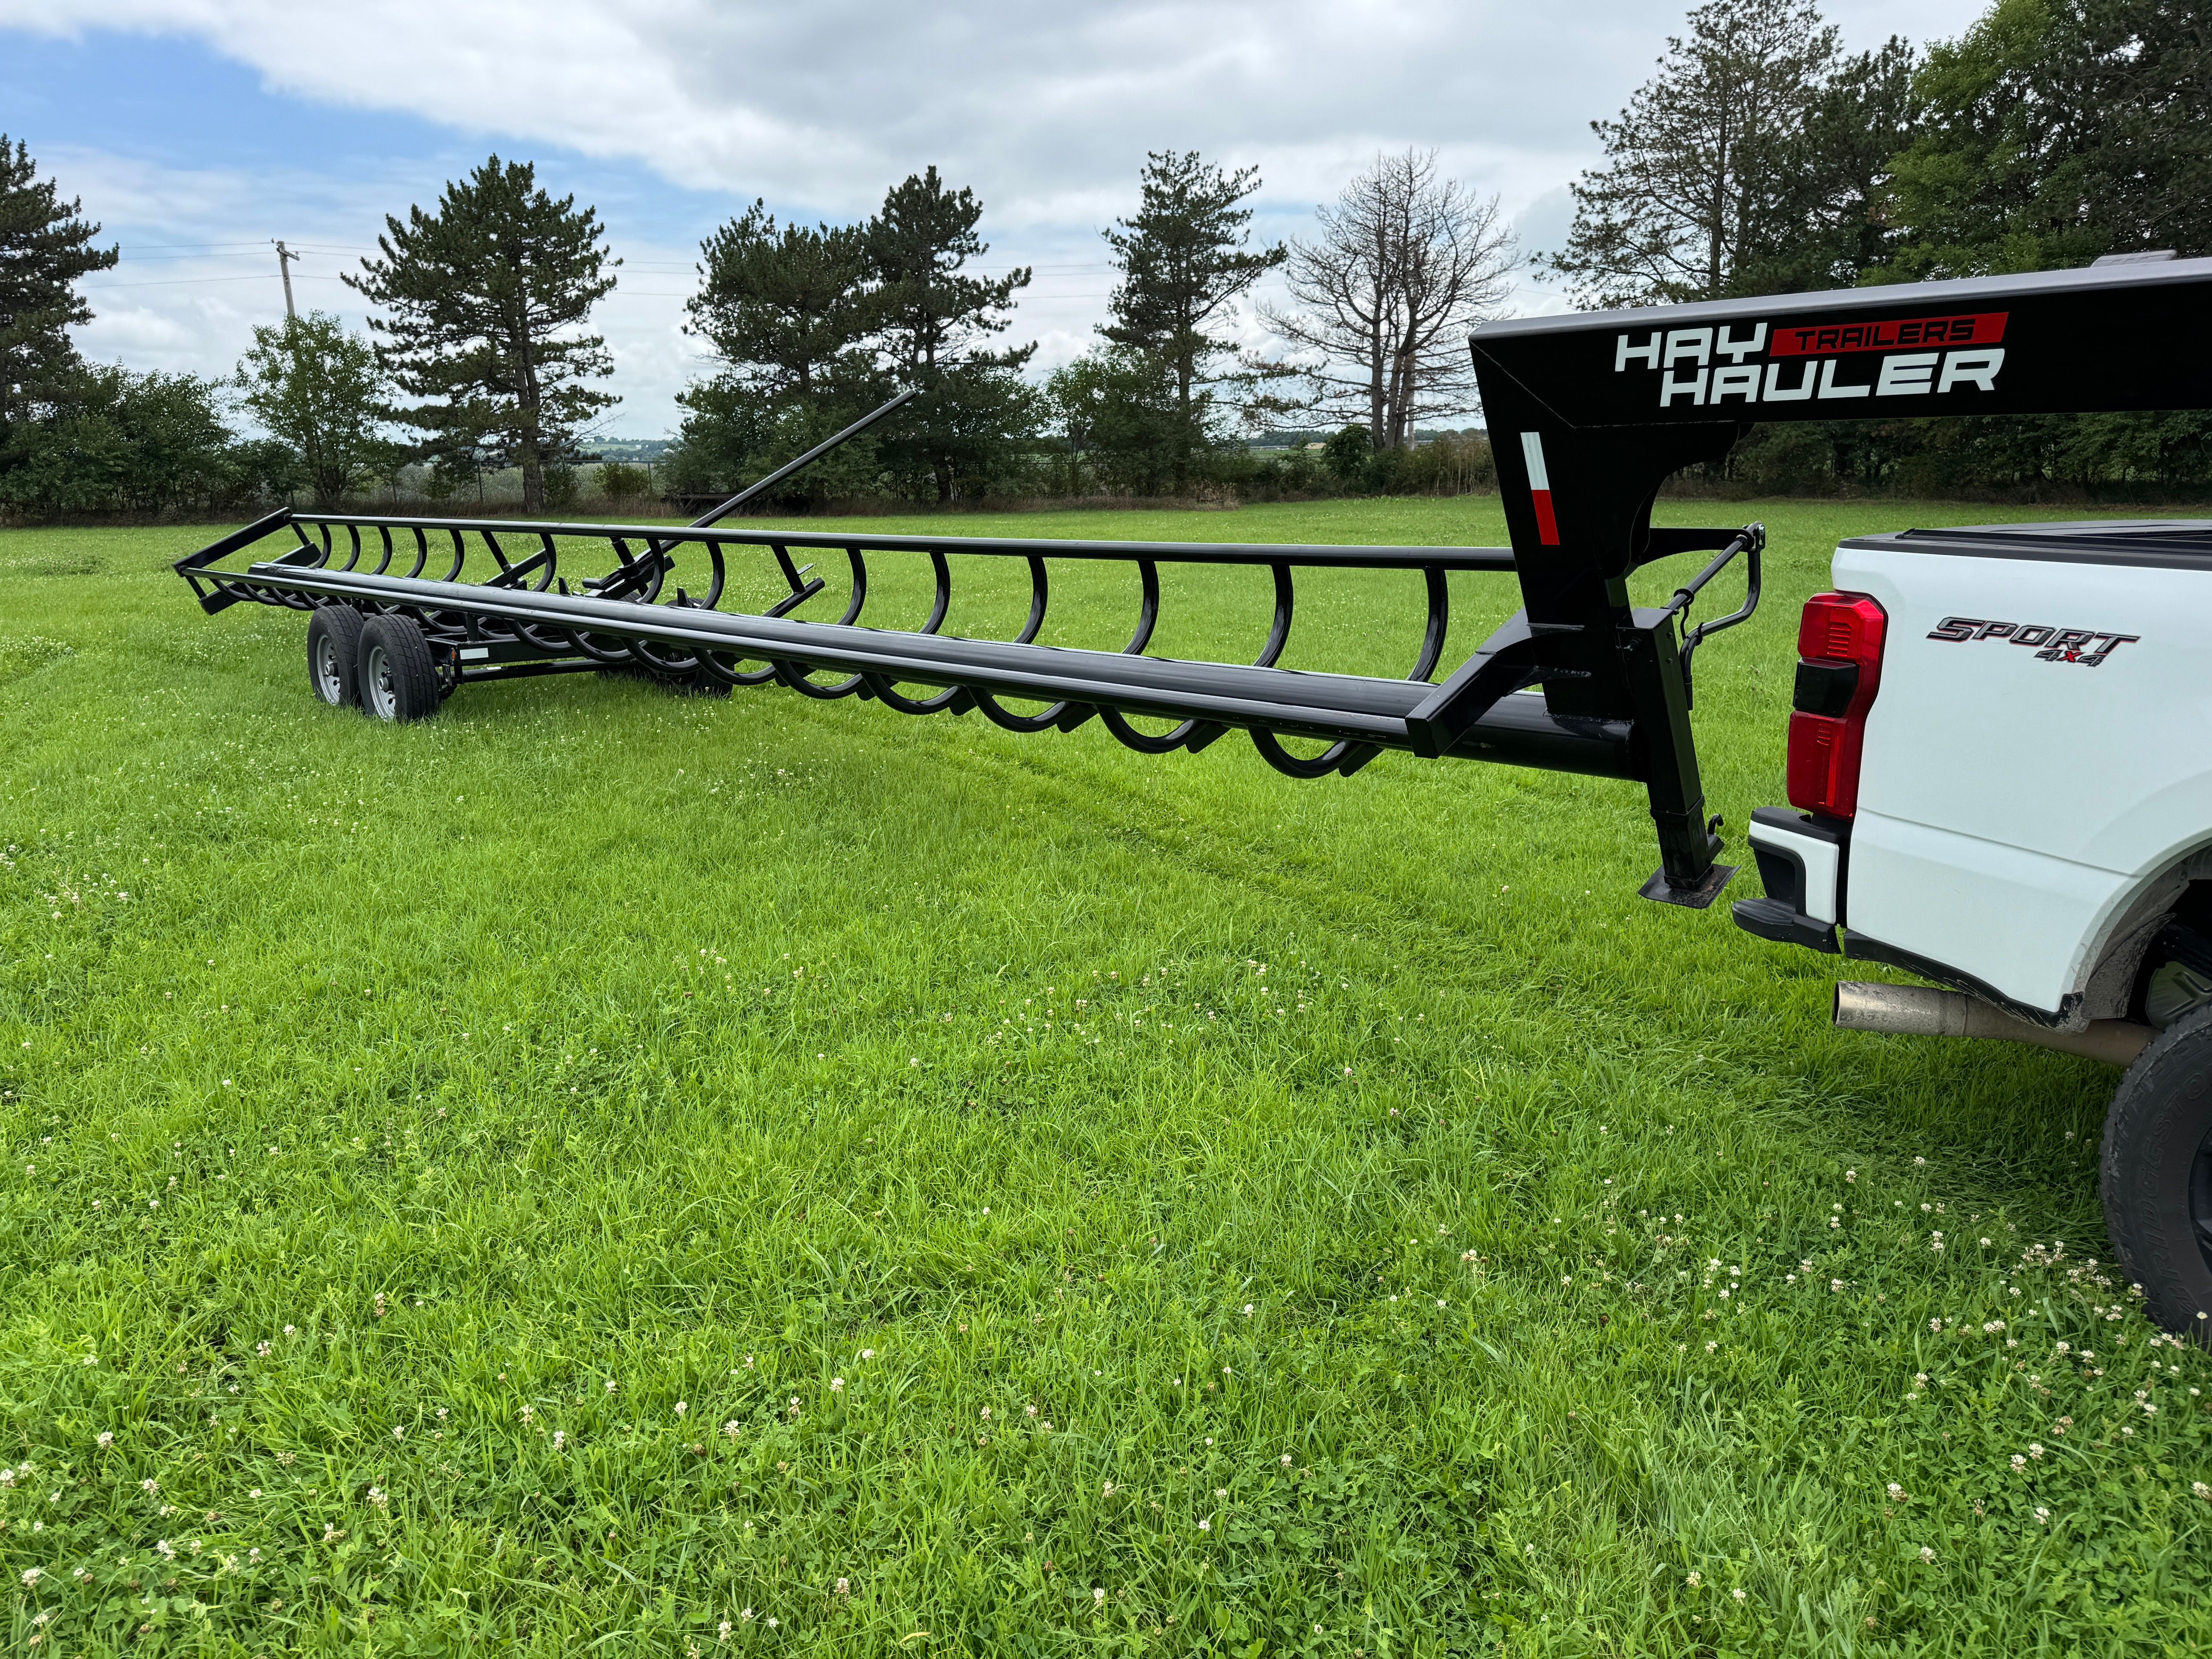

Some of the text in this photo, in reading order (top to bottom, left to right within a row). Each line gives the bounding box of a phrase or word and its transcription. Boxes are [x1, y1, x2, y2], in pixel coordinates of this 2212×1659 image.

[1615, 319, 1974, 372] HAY TRAILERS
[1660, 348, 2005, 407] HAULER
[1926, 616, 2141, 654] SPORT
[2136, 1060, 2212, 1316] BRIDGESTO
